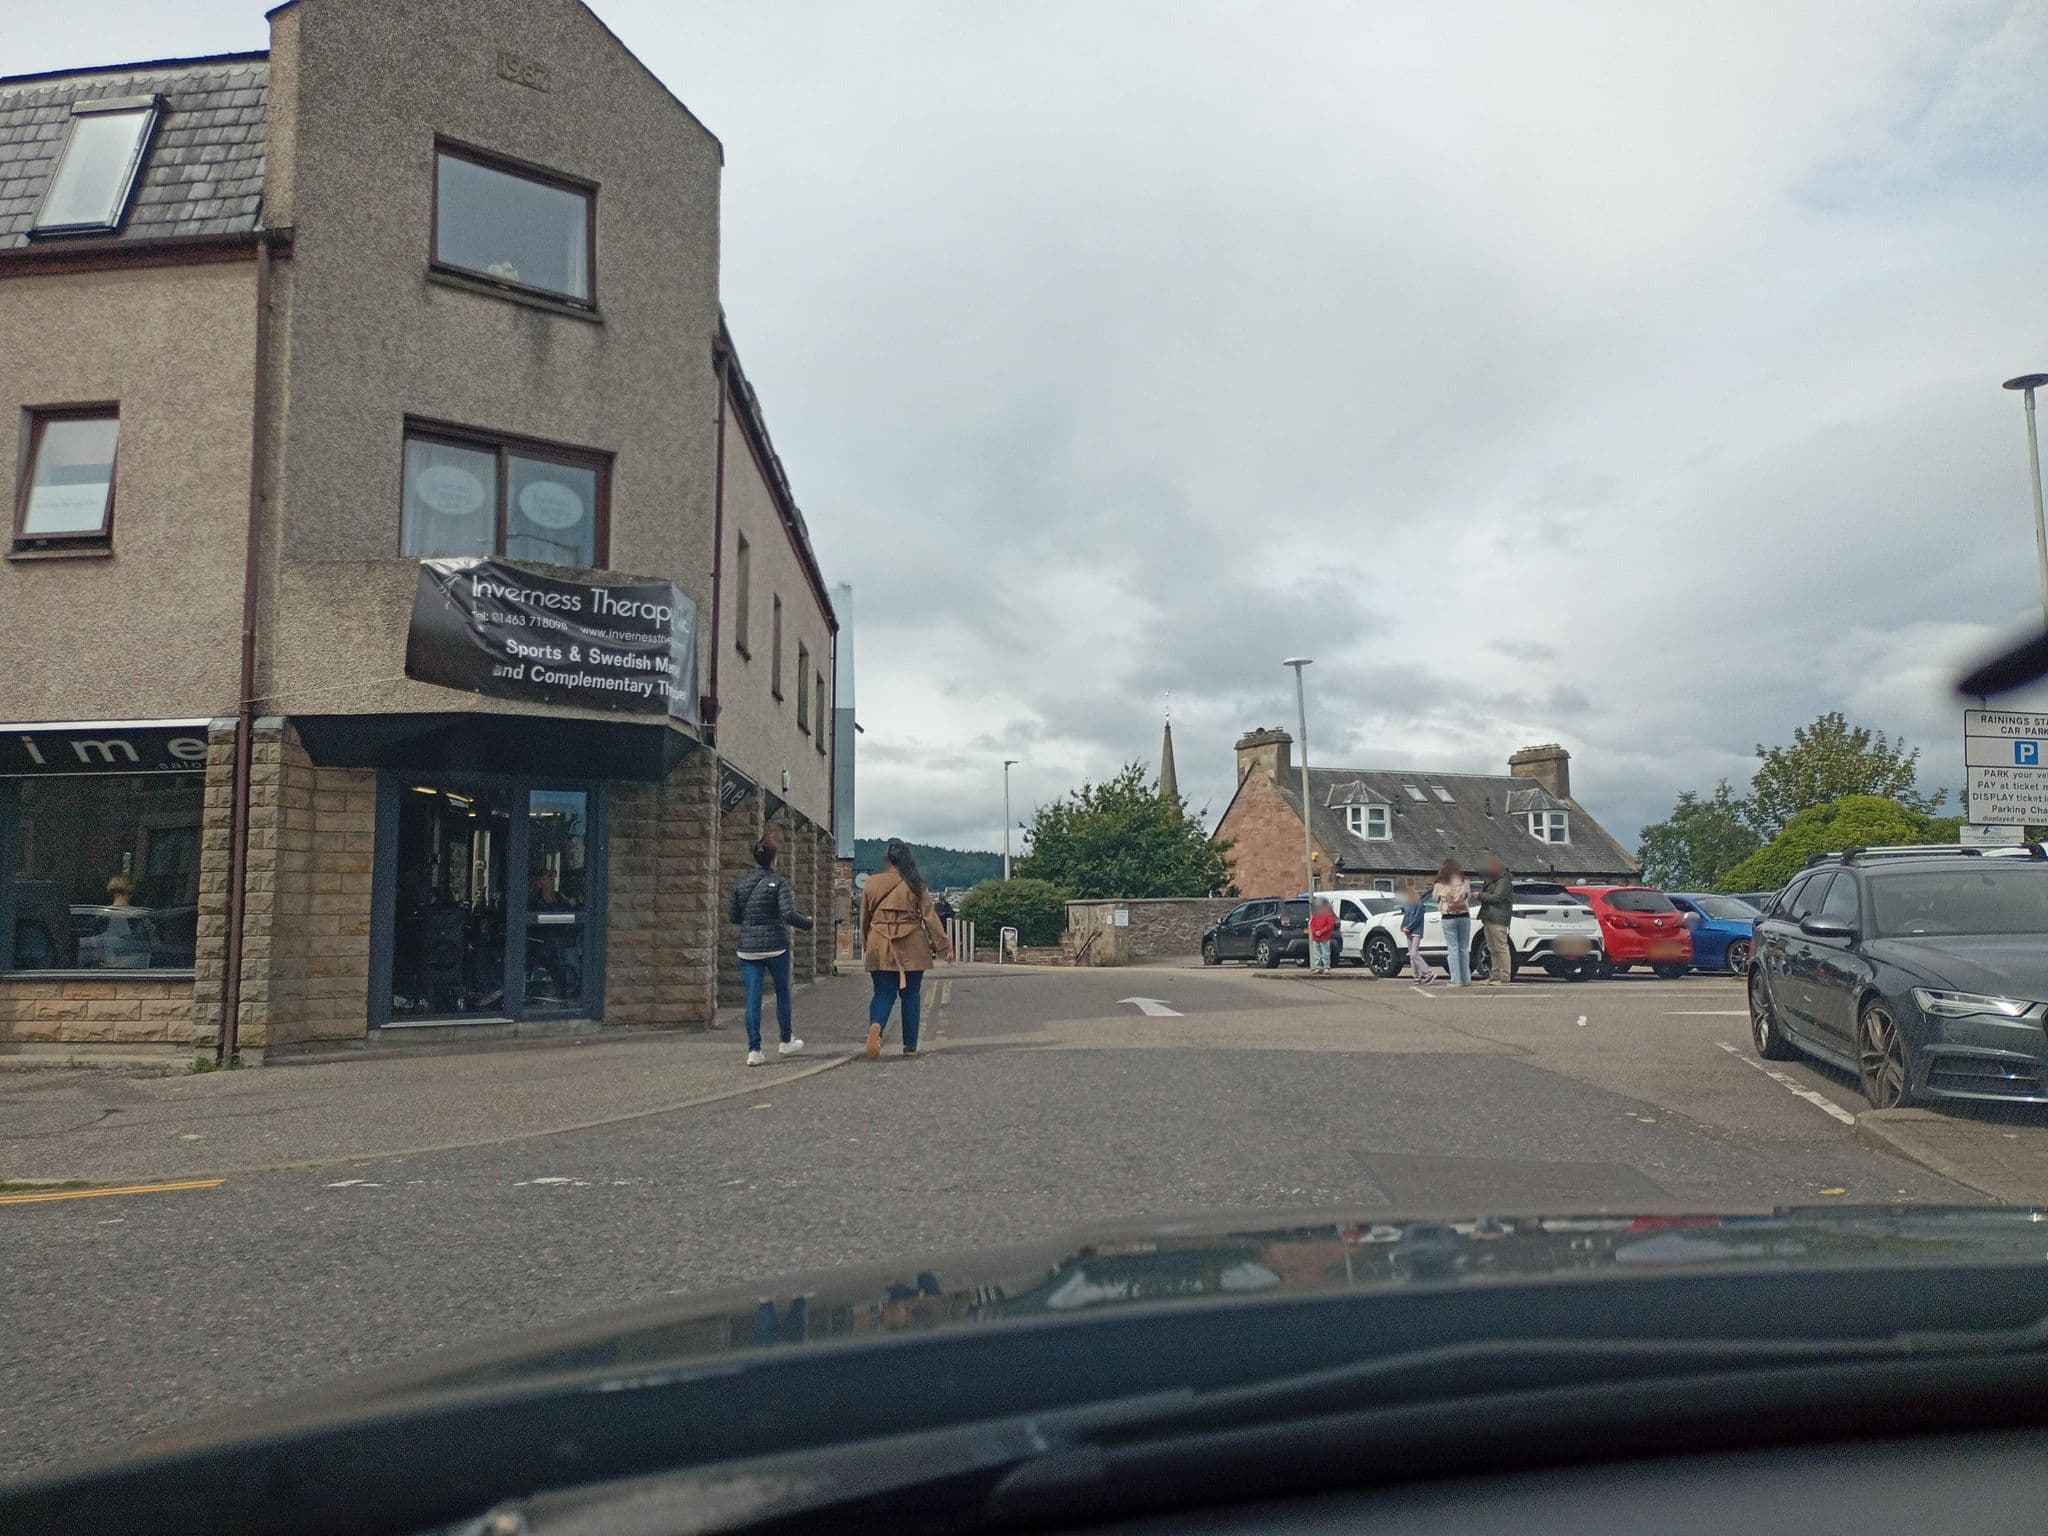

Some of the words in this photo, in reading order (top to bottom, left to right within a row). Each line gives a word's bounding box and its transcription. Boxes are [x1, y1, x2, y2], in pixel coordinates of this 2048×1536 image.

[472, 574, 582, 612] Inverness
[591, 588, 673, 629] Therap
[492, 611, 526, 626] 01463
[506, 638, 562, 661] Sports
[570, 645, 582, 662] &
[589, 648, 651, 671] Swedish
[493, 664, 525, 681] and
[531, 665, 653, 698] Complementary
[1980, 715, 2030, 726] RAININGS
[2000, 726, 2021, 735] CAR
[2020, 744, 2035, 763] P
[1984, 769, 2009, 778] PARK
[2013, 771, 2032, 780] your
[1977, 781, 1997, 790] PAY
[1999, 782, 2009, 790] at
[2013, 782, 2039, 791] ticket
[1972, 792, 2014, 801] DISPLAY
[2016, 793, 2042, 803] ticket
[1991, 804, 2026, 815] Parking
